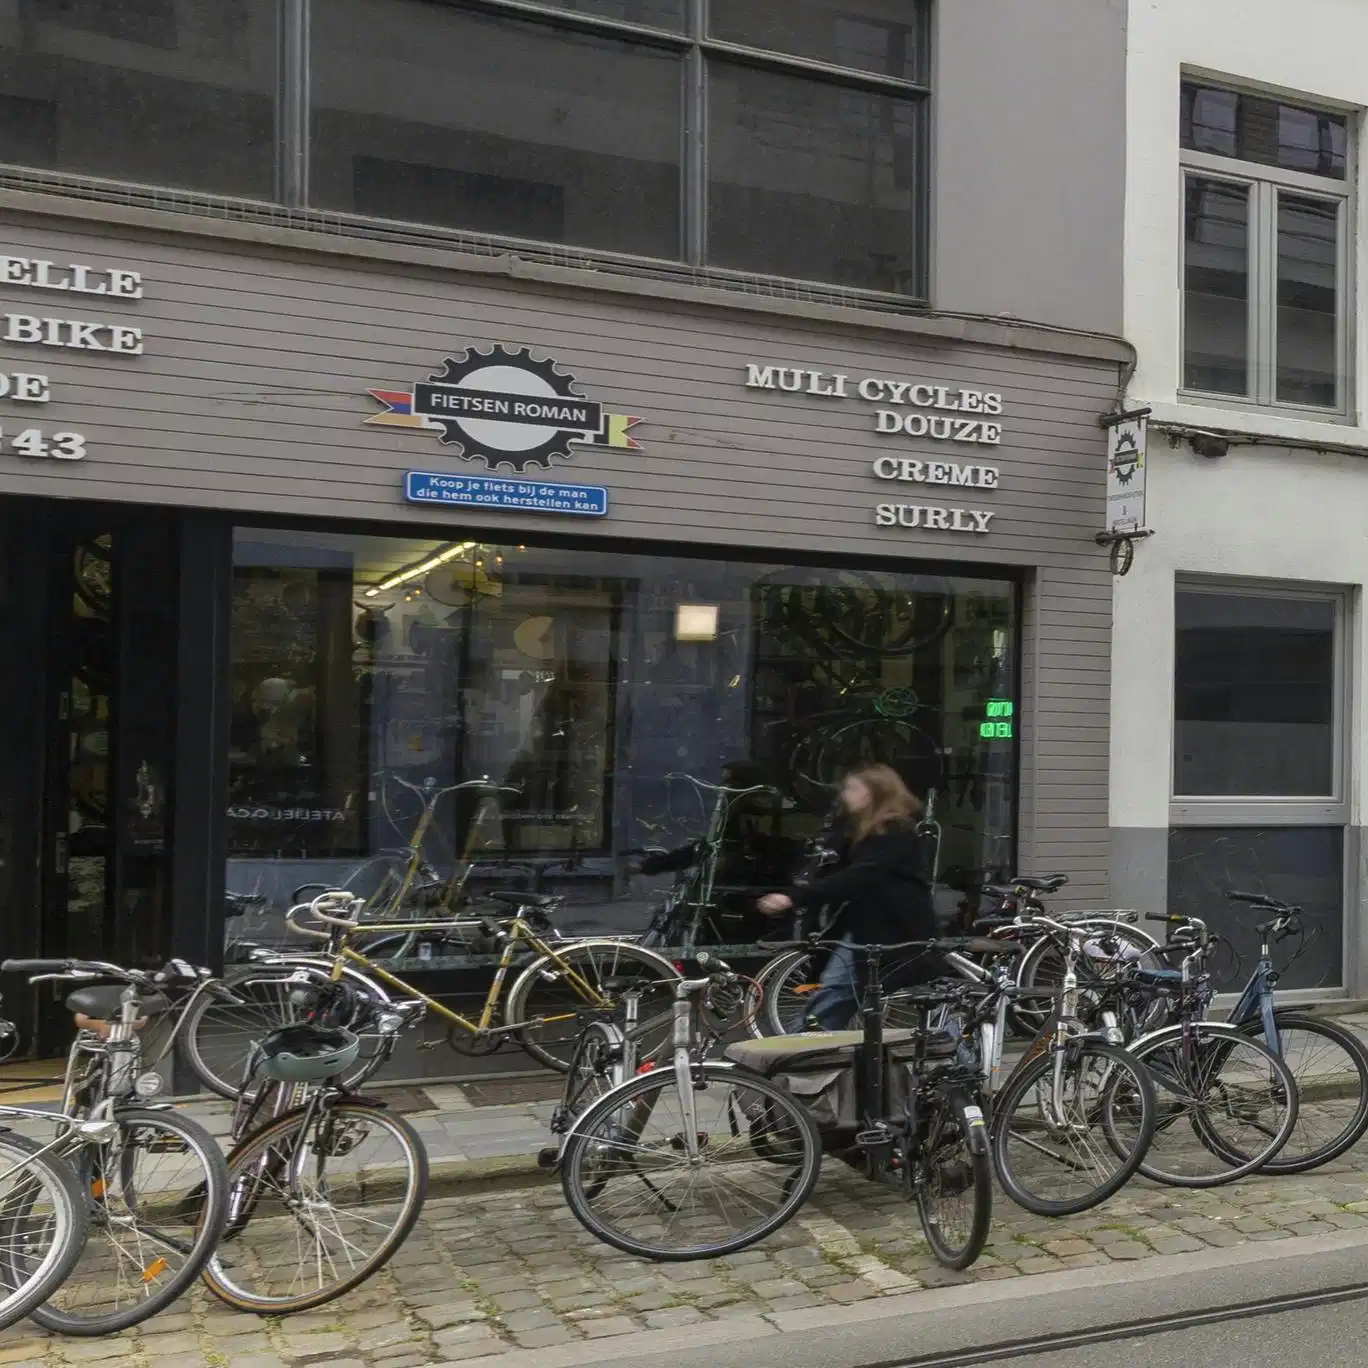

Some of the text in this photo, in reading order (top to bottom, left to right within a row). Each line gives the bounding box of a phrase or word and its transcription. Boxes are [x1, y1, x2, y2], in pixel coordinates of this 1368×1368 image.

[4, 313, 144, 355] BIKE
[745, 363, 1003, 415] MULI CYCLES
[430, 393, 587, 422] FIETSEN ROMAN
[875, 410, 1002, 445] DOUZE
[429, 477, 588, 499] Koop je fiets bij de man
[872, 456, 1000, 489] CREME
[416, 488, 598, 511] die hem ook herstellen kan
[875, 503, 996, 533] SURLY
